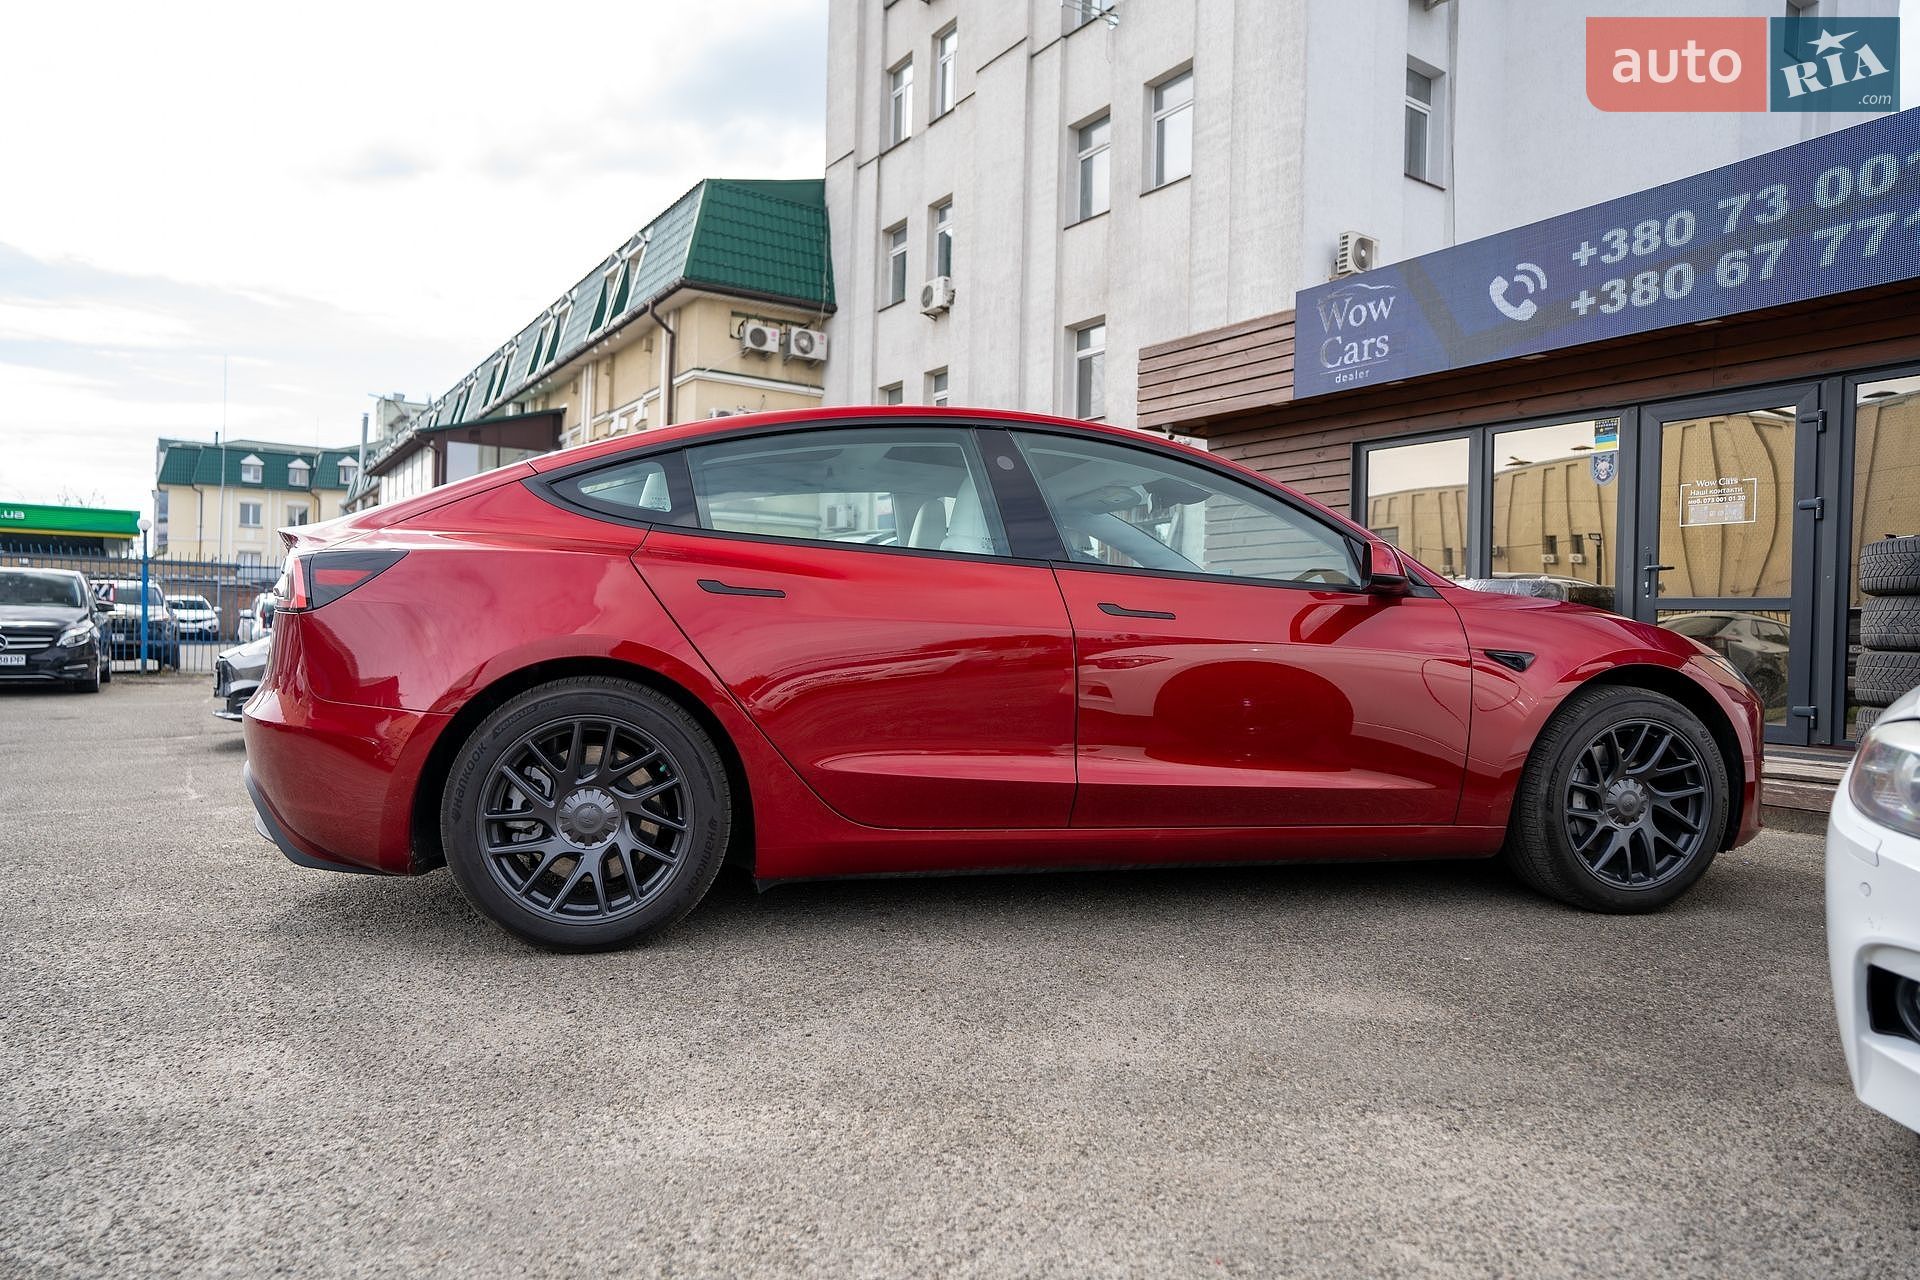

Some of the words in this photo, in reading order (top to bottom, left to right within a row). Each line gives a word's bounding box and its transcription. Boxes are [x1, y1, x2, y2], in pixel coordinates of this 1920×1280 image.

[1572, 209, 1696, 267] +380
[1718, 183, 1789, 234] 73
[1814, 150, 1920, 209] 00
[1571, 262, 1695, 316] +380
[1716, 239, 1789, 288] 67
[1814, 209, 1920, 268] 77
[1317, 296, 1396, 334] Wow
[1320, 335, 1389, 368] Cars
[1335, 369, 1370, 383] dealer
[1696, 479, 1717, 487] Wow
[1709, 487, 1743, 495] контакти
